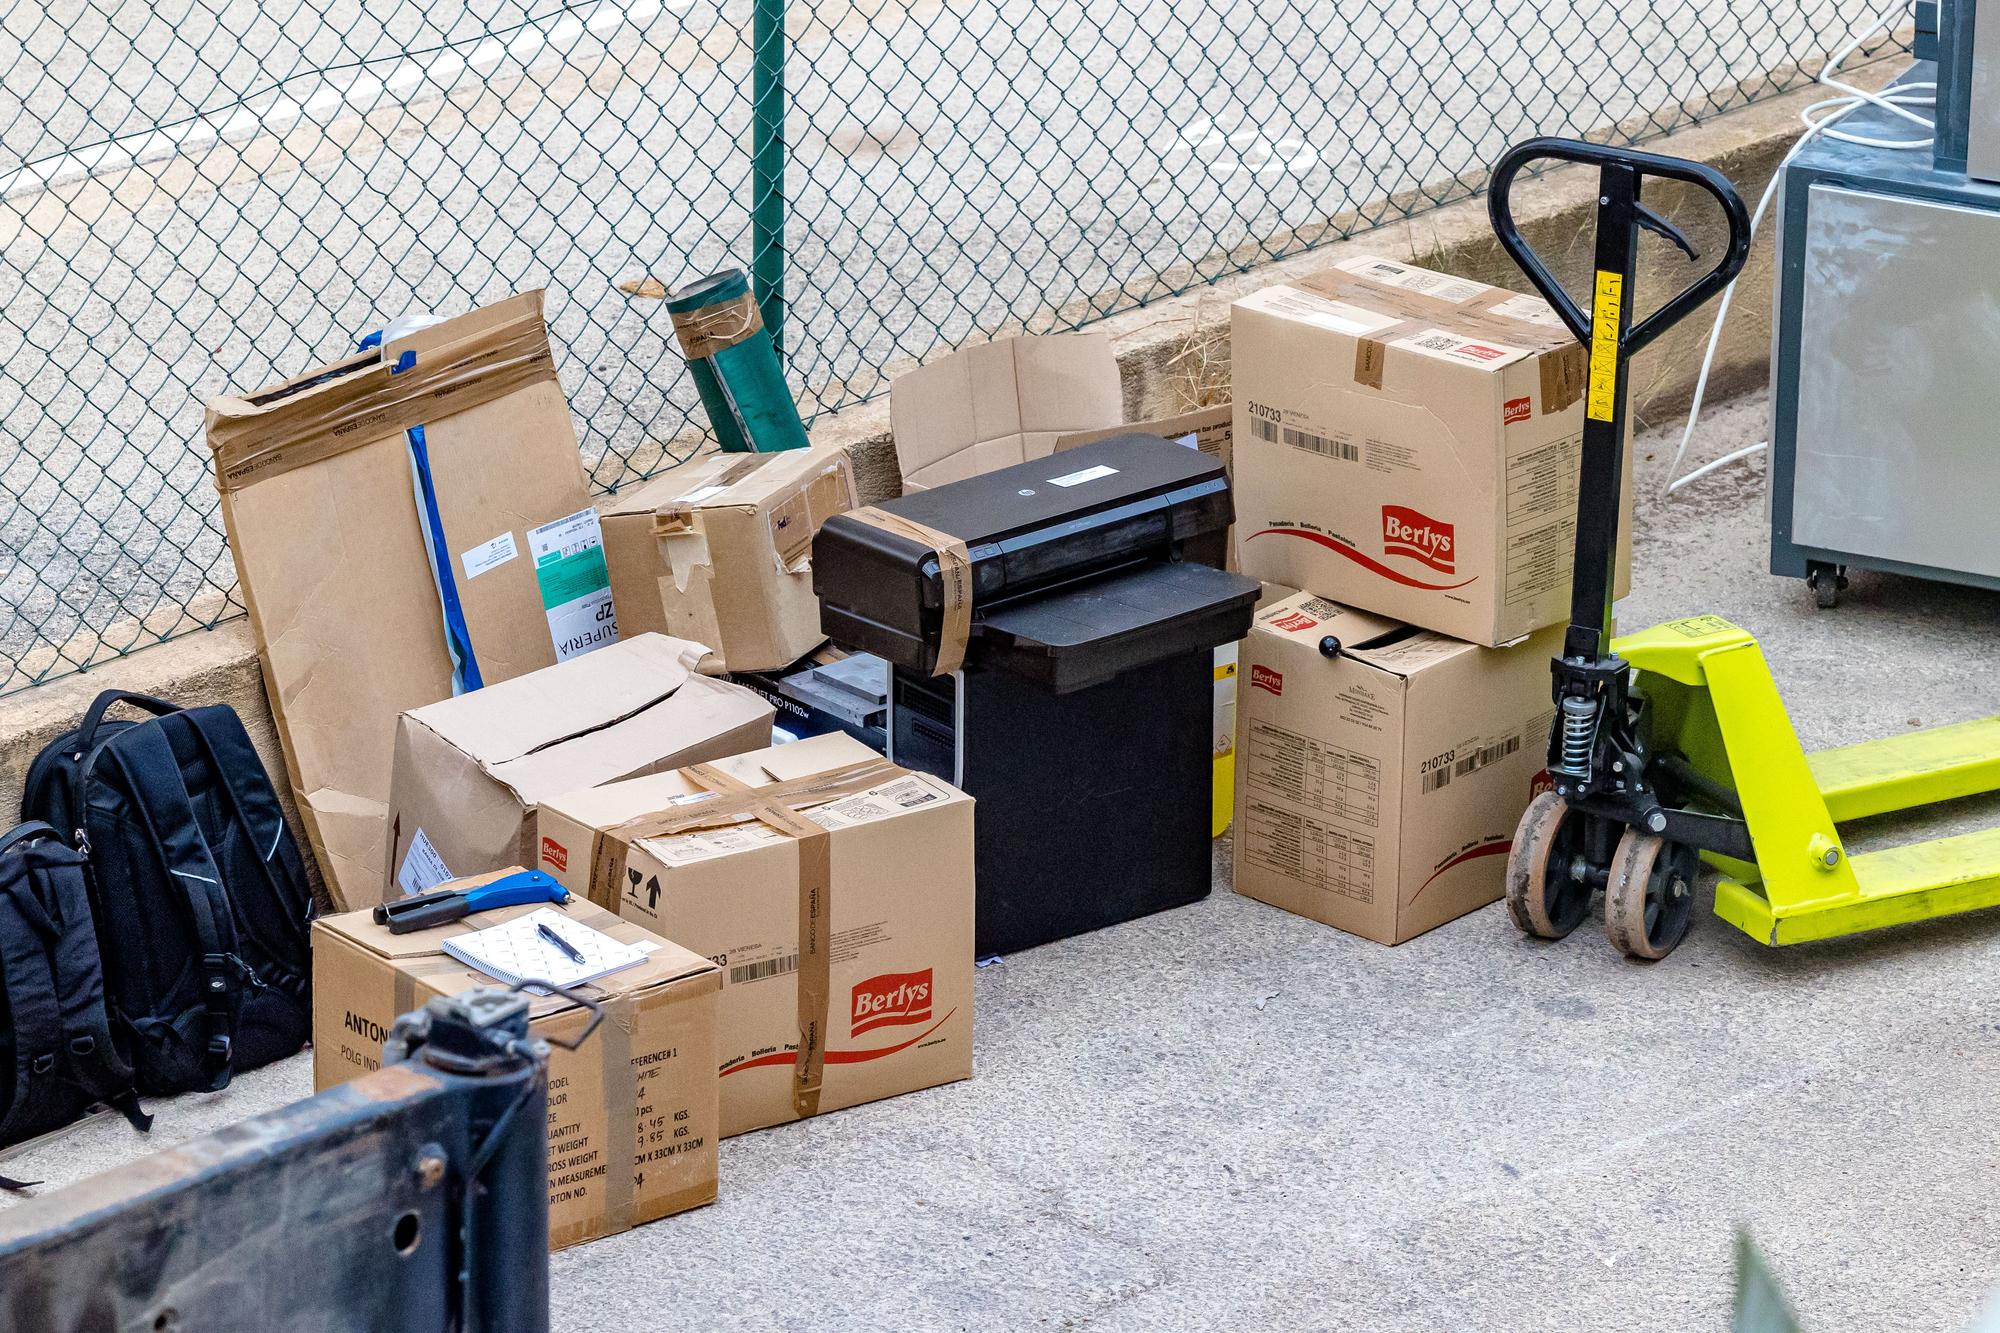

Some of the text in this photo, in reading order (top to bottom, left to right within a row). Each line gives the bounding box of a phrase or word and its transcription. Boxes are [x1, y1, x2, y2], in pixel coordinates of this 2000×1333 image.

[1248, 401, 1281, 423] 210733
[1504, 402, 1530, 417] Berlys
[1386, 515, 1451, 558] Berlys
[595, 601, 613, 622] ZP
[558, 621, 619, 656] SUPERIA
[1253, 669, 1281, 687] Berlys
[769, 693, 784, 707] PRO
[784, 700, 809, 719] P1102w
[1421, 749, 1455, 774] 210733
[543, 842, 567, 863] Berlys
[854, 982, 928, 1017] Berlys
[341, 1044, 361, 1066] POLG
[672, 1048, 677, 1058] 1
[784, 1043, 800, 1051] Past
[547, 1077, 569, 1090] ODEL
[636, 1067, 662, 1083] HITE
[547, 1112, 557, 1124] ZE
[640, 1105, 653, 1117] pcs
[674, 1109, 690, 1122] KGS.
[674, 1126, 690, 1138] KGS.
[558, 1137, 589, 1154] WEIGHT
[647, 1152, 653, 1162] X
[654, 1146, 676, 1160] 33CM
[676, 1144, 682, 1154] X
[683, 1137, 704, 1152] 33CM
[547, 1151, 599, 1173] ROSS WEIGHT
[558, 1164, 607, 1186] MEASUREME
[550, 1187, 588, 1206] RTON NO.
